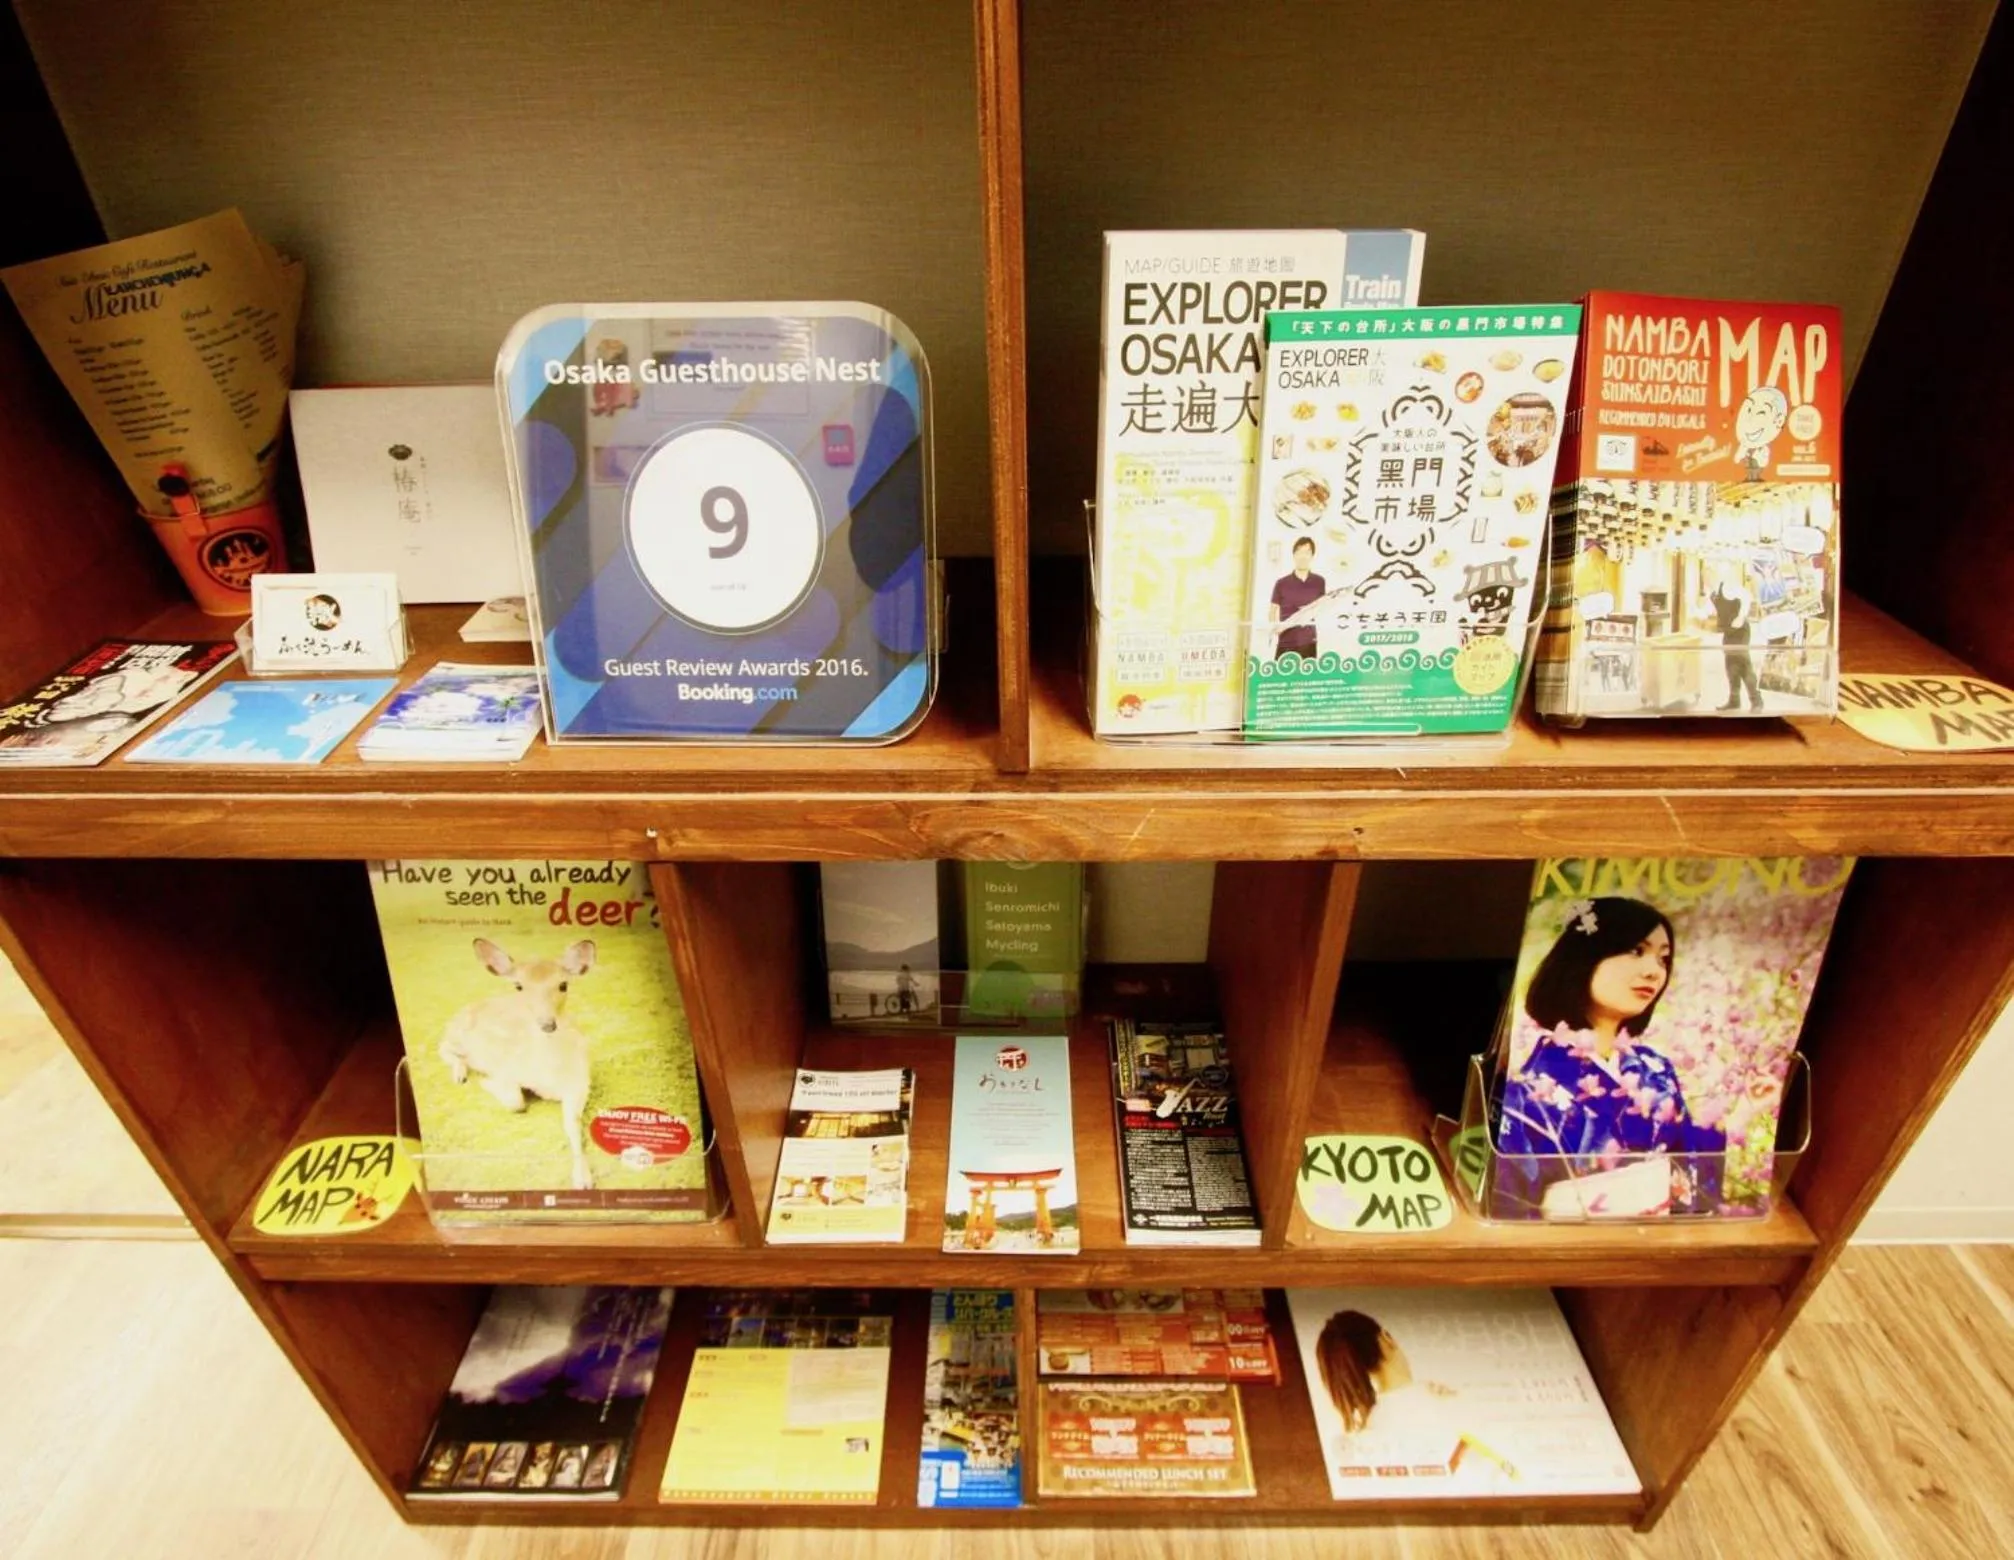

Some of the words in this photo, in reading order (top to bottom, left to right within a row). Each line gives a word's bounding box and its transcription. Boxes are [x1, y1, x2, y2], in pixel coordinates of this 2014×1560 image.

[1123, 280, 1328, 326] EXPLORER
[1345, 274, 1402, 301] Train
[69, 283, 164, 325] Menu
[1120, 331, 1262, 377] OSAKA
[1279, 348, 1369, 368] EXPLORER
[1602, 354, 1710, 385] DOTONBORI
[1605, 313, 1711, 358] NAMBA
[1717, 316, 1828, 408] MAP
[543, 358, 631, 385] Osaka
[640, 356, 808, 385] Guesthouse
[816, 357, 881, 382] Nest
[1278, 370, 1340, 389] OSAKA
[700, 485, 749, 560] 9
[1374, 494, 1437, 525] 市場
[604, 658, 662, 677] Guest
[667, 658, 733, 677] Review
[739, 658, 810, 677] Awards
[816, 658, 869, 677] 2016.
[677, 682, 798, 704] Booking.com
[1838, 679, 2012, 712] NAMBA
[382, 862, 453, 885] Have
[465, 864, 516, 886] you
[530, 860, 632, 886] already
[984, 881, 1018, 893] Ibuki
[1535, 857, 1859, 899] KIMONO
[445, 889, 500, 906] seen
[506, 883, 547, 906] the
[278, 1141, 395, 1185] NARA
[1301, 1141, 1431, 1184] KYOTO
[259, 1187, 356, 1226] MAP
[1355, 1192, 1442, 1229] MAP
[1063, 1465, 1160, 1481] RECOMMENDED
[1161, 1466, 1202, 1481] LUNCH
[1206, 1467, 1228, 1481] SET
